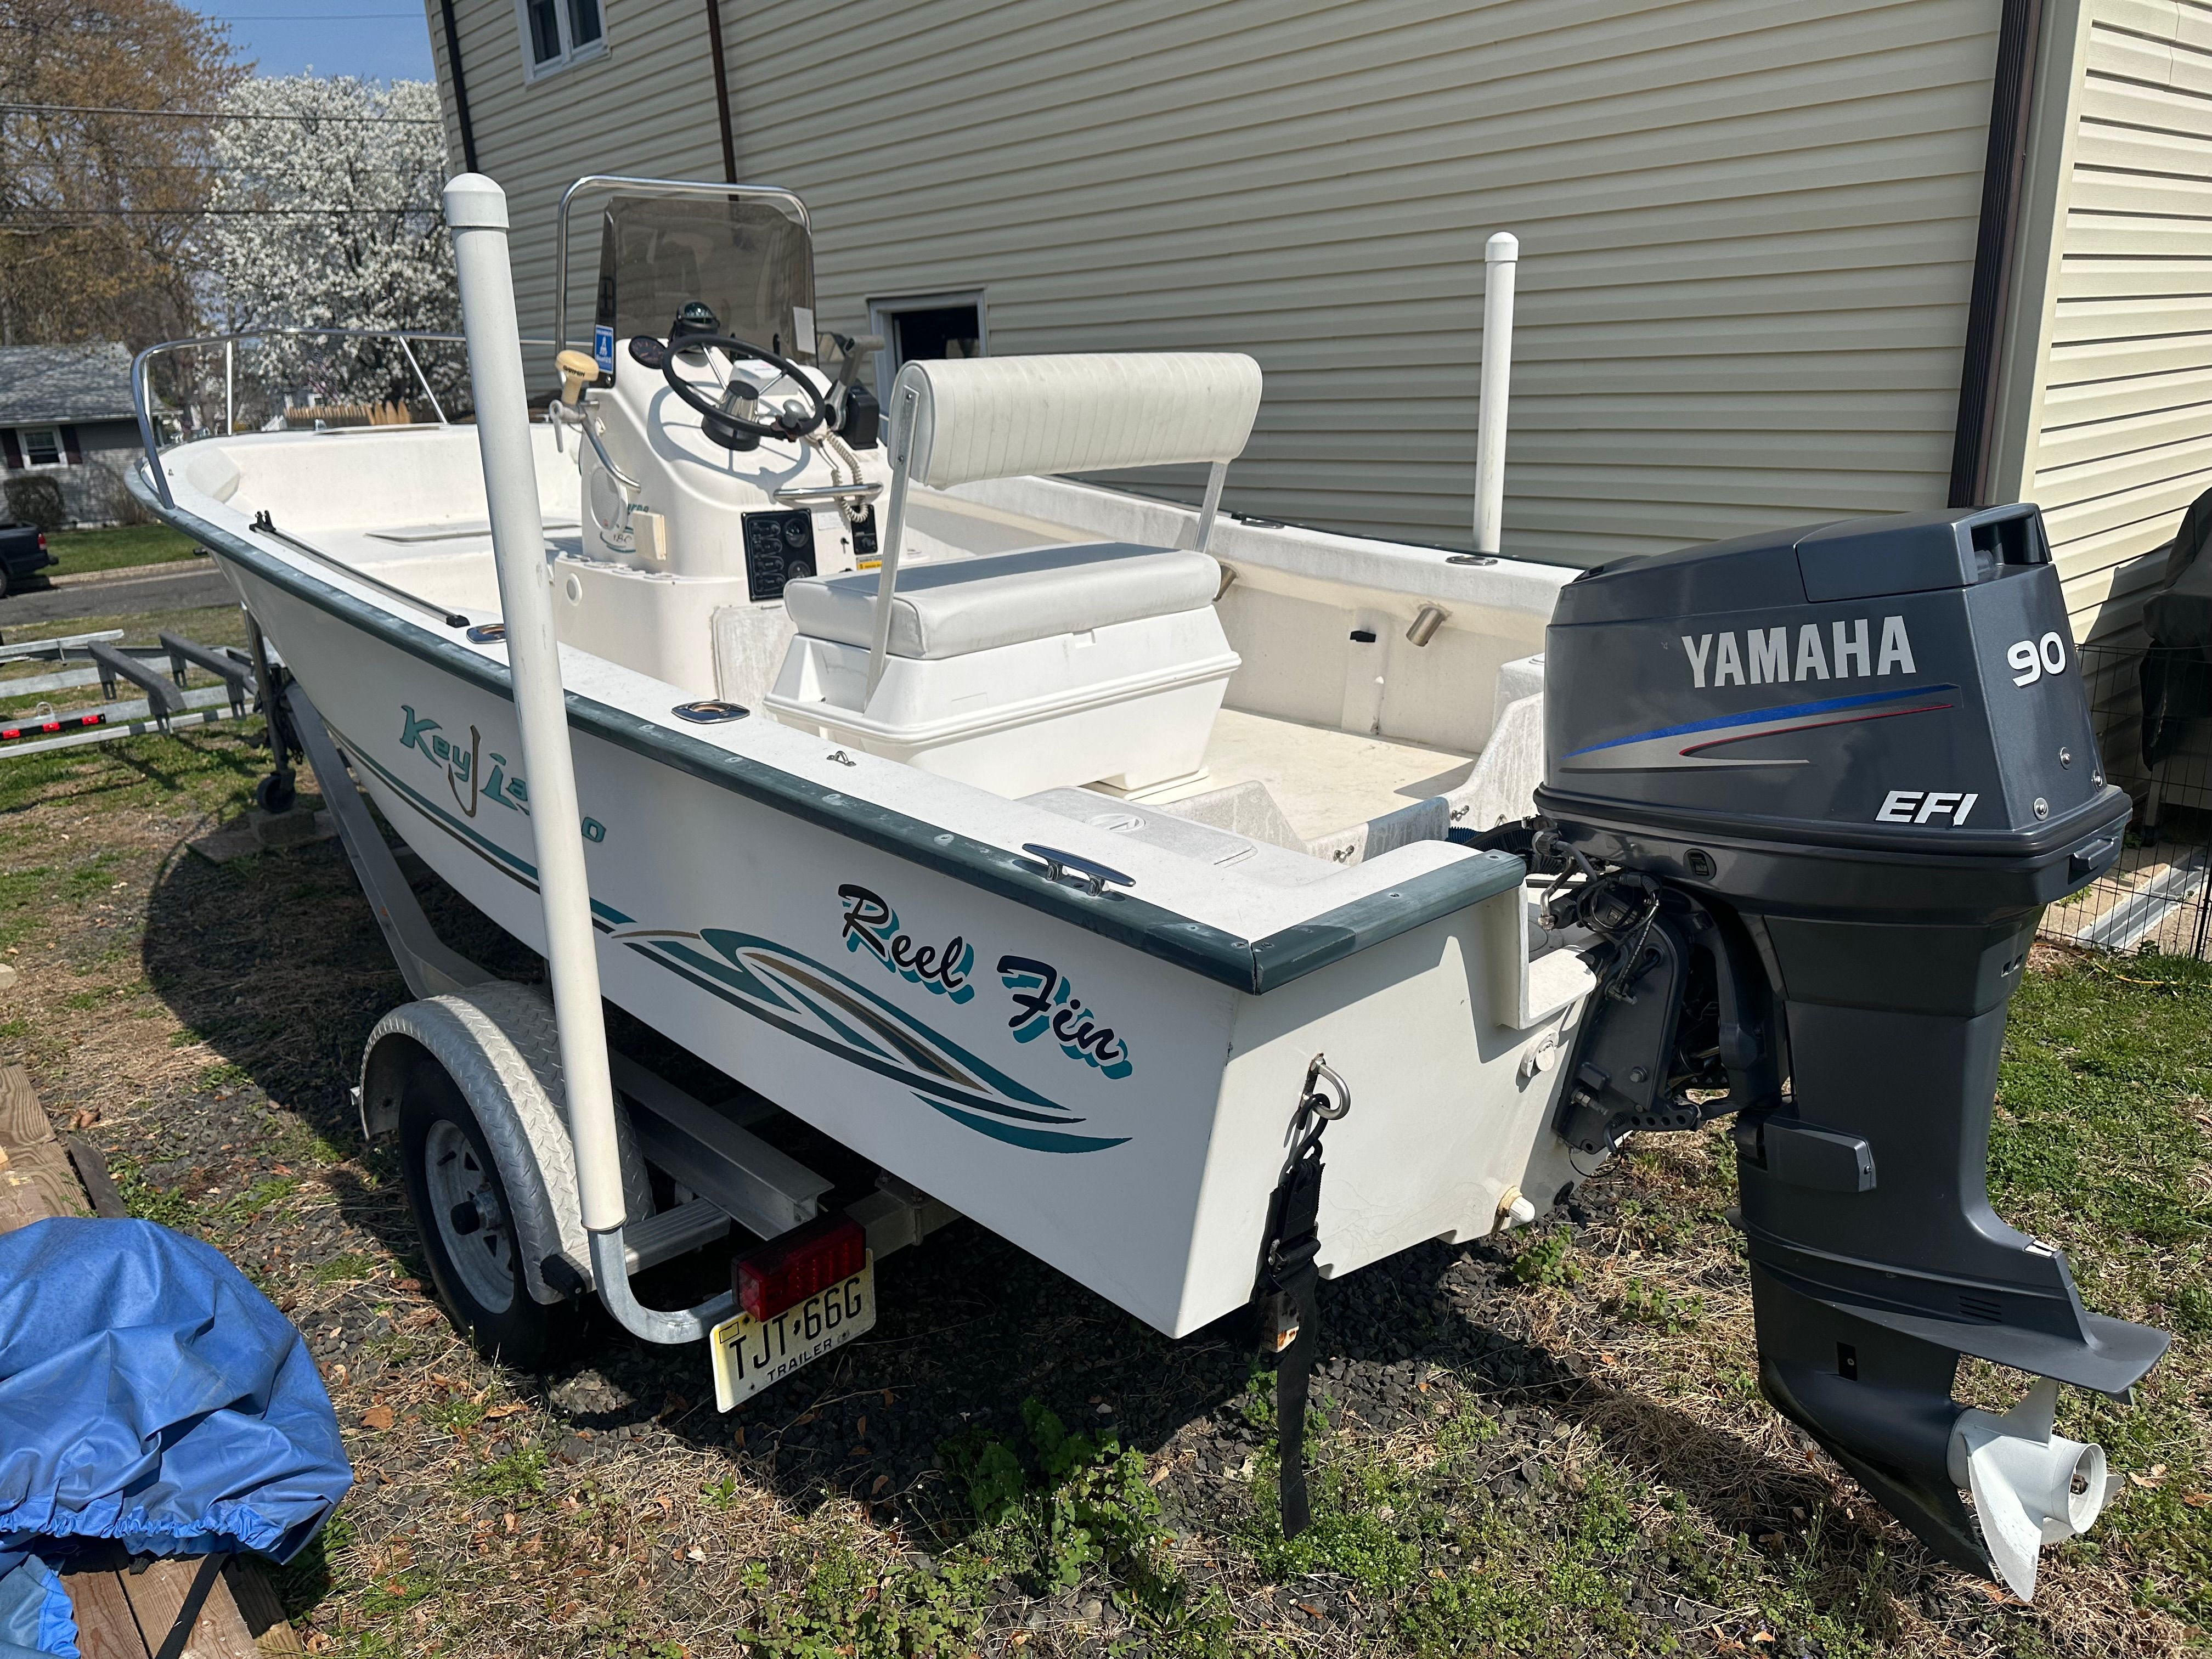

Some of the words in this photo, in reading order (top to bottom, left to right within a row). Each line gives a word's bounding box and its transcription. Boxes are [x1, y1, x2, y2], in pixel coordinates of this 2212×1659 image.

[1681, 615, 1917, 689] YAMAHA
[2006, 631, 2066, 688] 90
[400, 705, 471, 782] Key
[479, 753, 607, 843] Lao
[1875, 790, 1979, 827] EFI
[838, 884, 974, 1004] Reel
[996, 955, 1132, 1079] Fin
[767, 1338, 832, 1382] TRAILER
